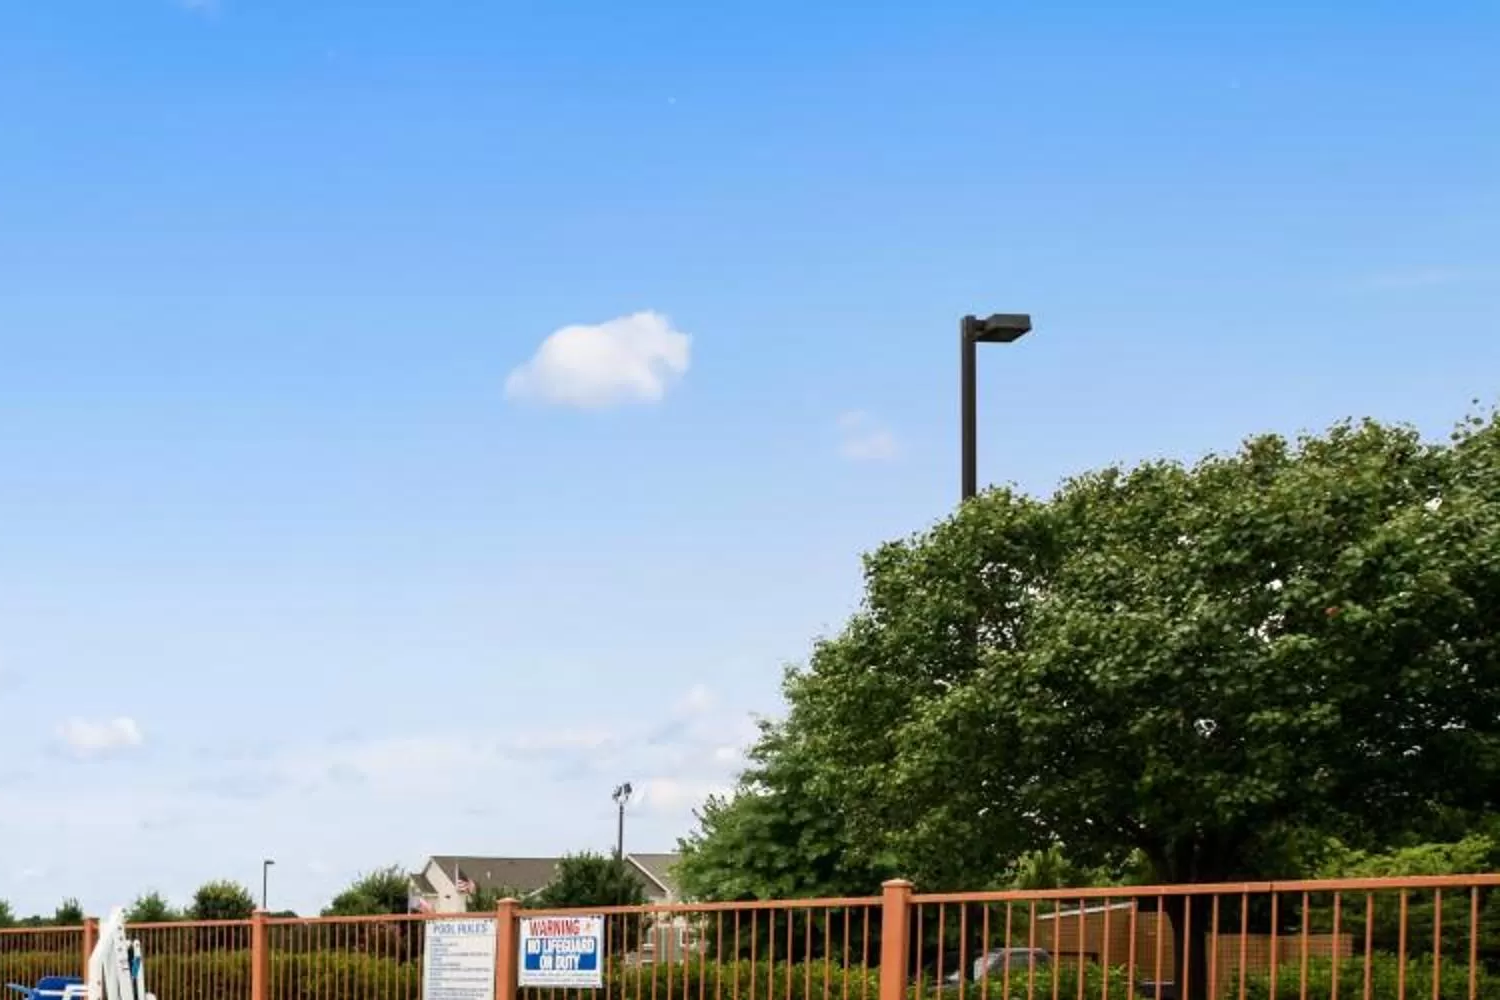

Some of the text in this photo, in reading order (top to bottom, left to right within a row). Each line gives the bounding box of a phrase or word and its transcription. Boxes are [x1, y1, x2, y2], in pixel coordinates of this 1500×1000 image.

[433, 923, 456, 934] POOL
[528, 919, 580, 937] WARNING
[542, 938, 595, 953] LIFEGUARD
[554, 955, 580, 970] DUTY
